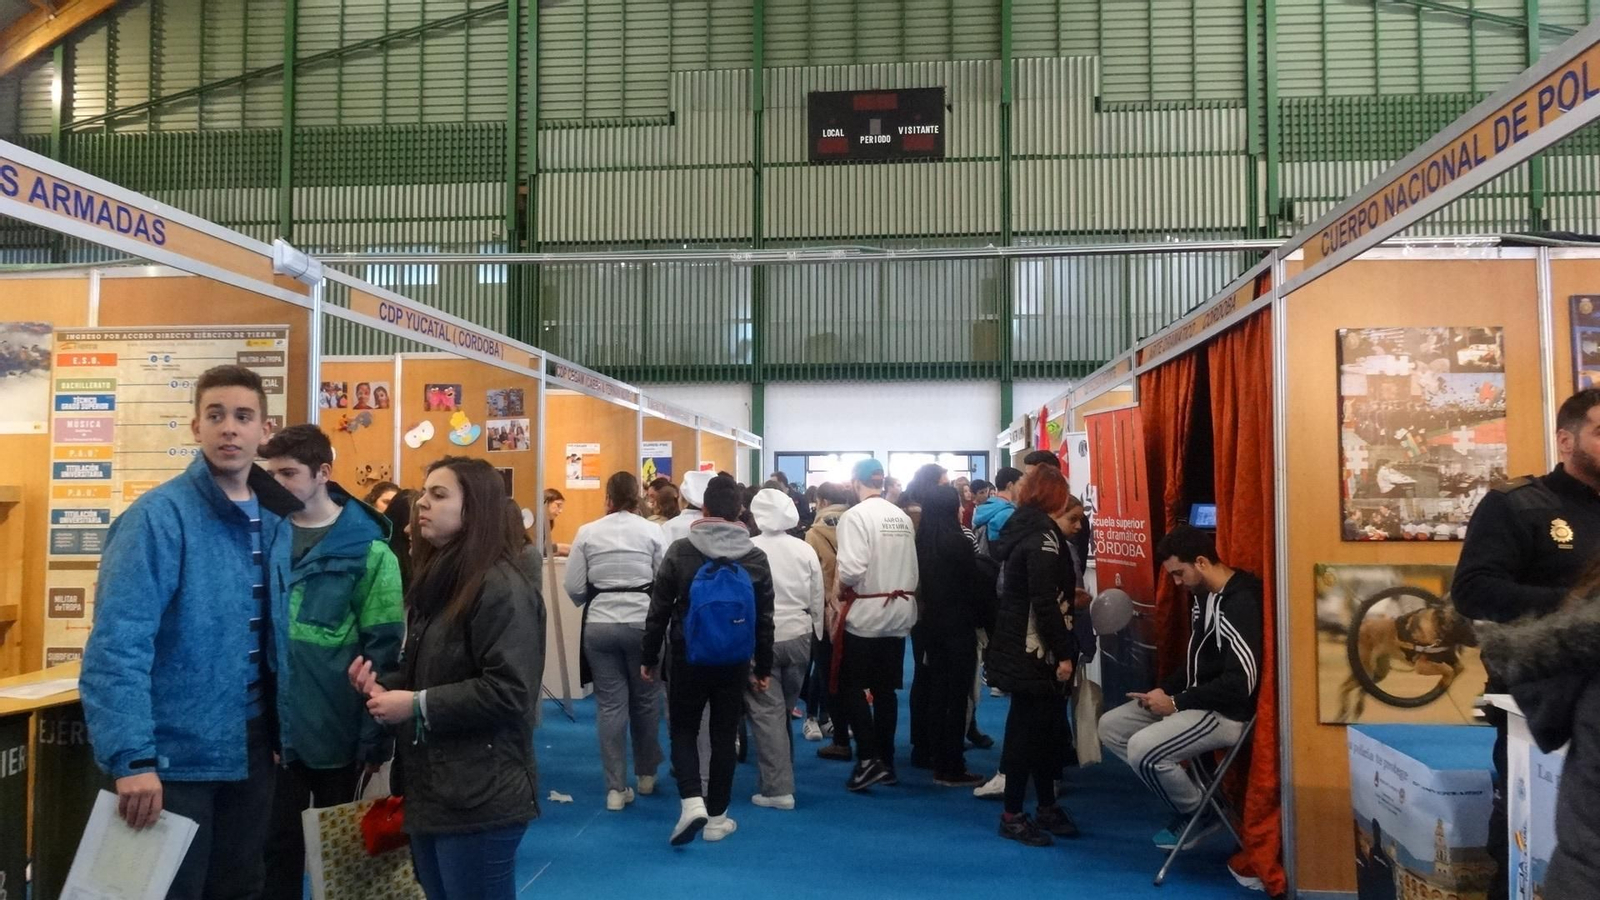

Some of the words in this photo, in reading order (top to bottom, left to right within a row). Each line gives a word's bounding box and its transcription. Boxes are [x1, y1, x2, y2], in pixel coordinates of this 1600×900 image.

[822, 128, 845, 138] LOCAL
[898, 125, 939, 135] VISITANTE
[860, 135, 891, 144] PERIODO
[1321, 205, 1380, 257] CUERPO
[1383, 133, 1487, 221] NACIONAL
[1493, 100, 1529, 154] DE
[28, 176, 166, 246] ARMADAS
[379, 301, 404, 322] CDP
[405, 310, 451, 342] YUCATAL
[1092, 516, 1115, 527] scuela
[1115, 517, 1146, 530] superior
[54, 595, 77, 603] MILITAR
[1537, 763, 1554, 783] La
